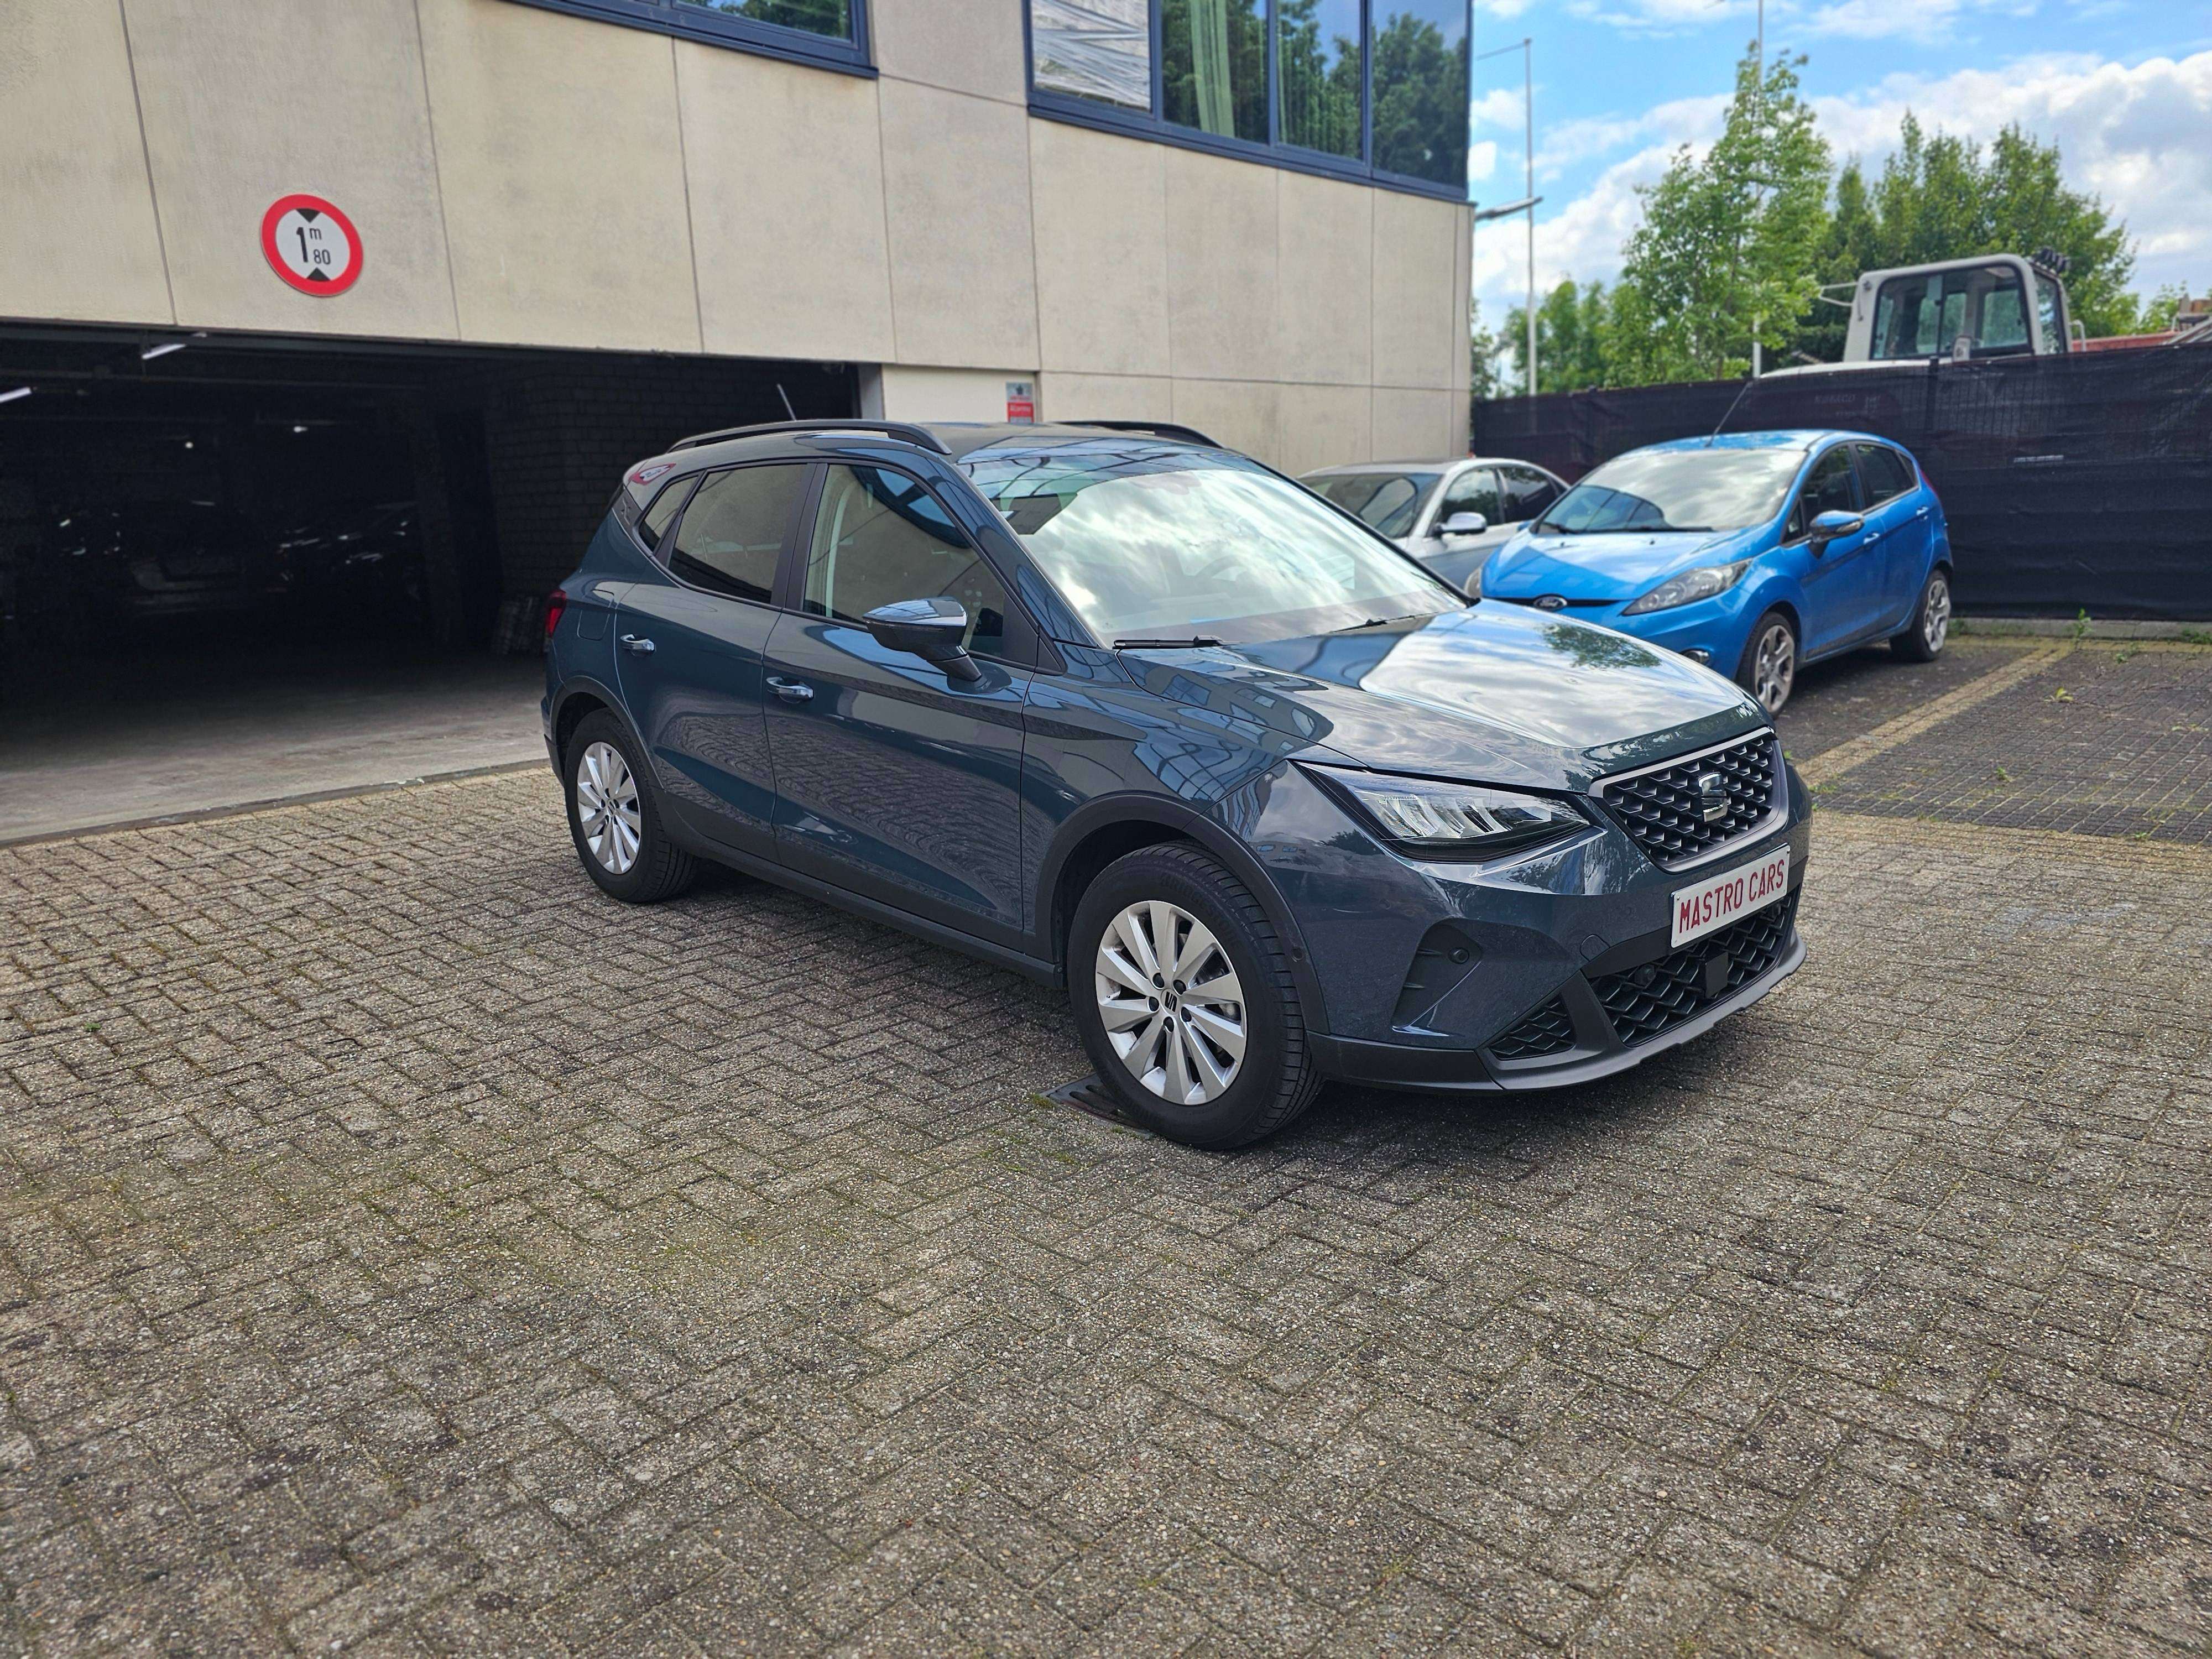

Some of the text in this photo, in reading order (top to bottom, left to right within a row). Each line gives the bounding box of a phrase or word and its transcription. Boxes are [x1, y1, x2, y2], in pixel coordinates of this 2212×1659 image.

[296, 226, 331, 265] 1 m 80
[1679, 859, 1784, 933] MASTRO CARS
